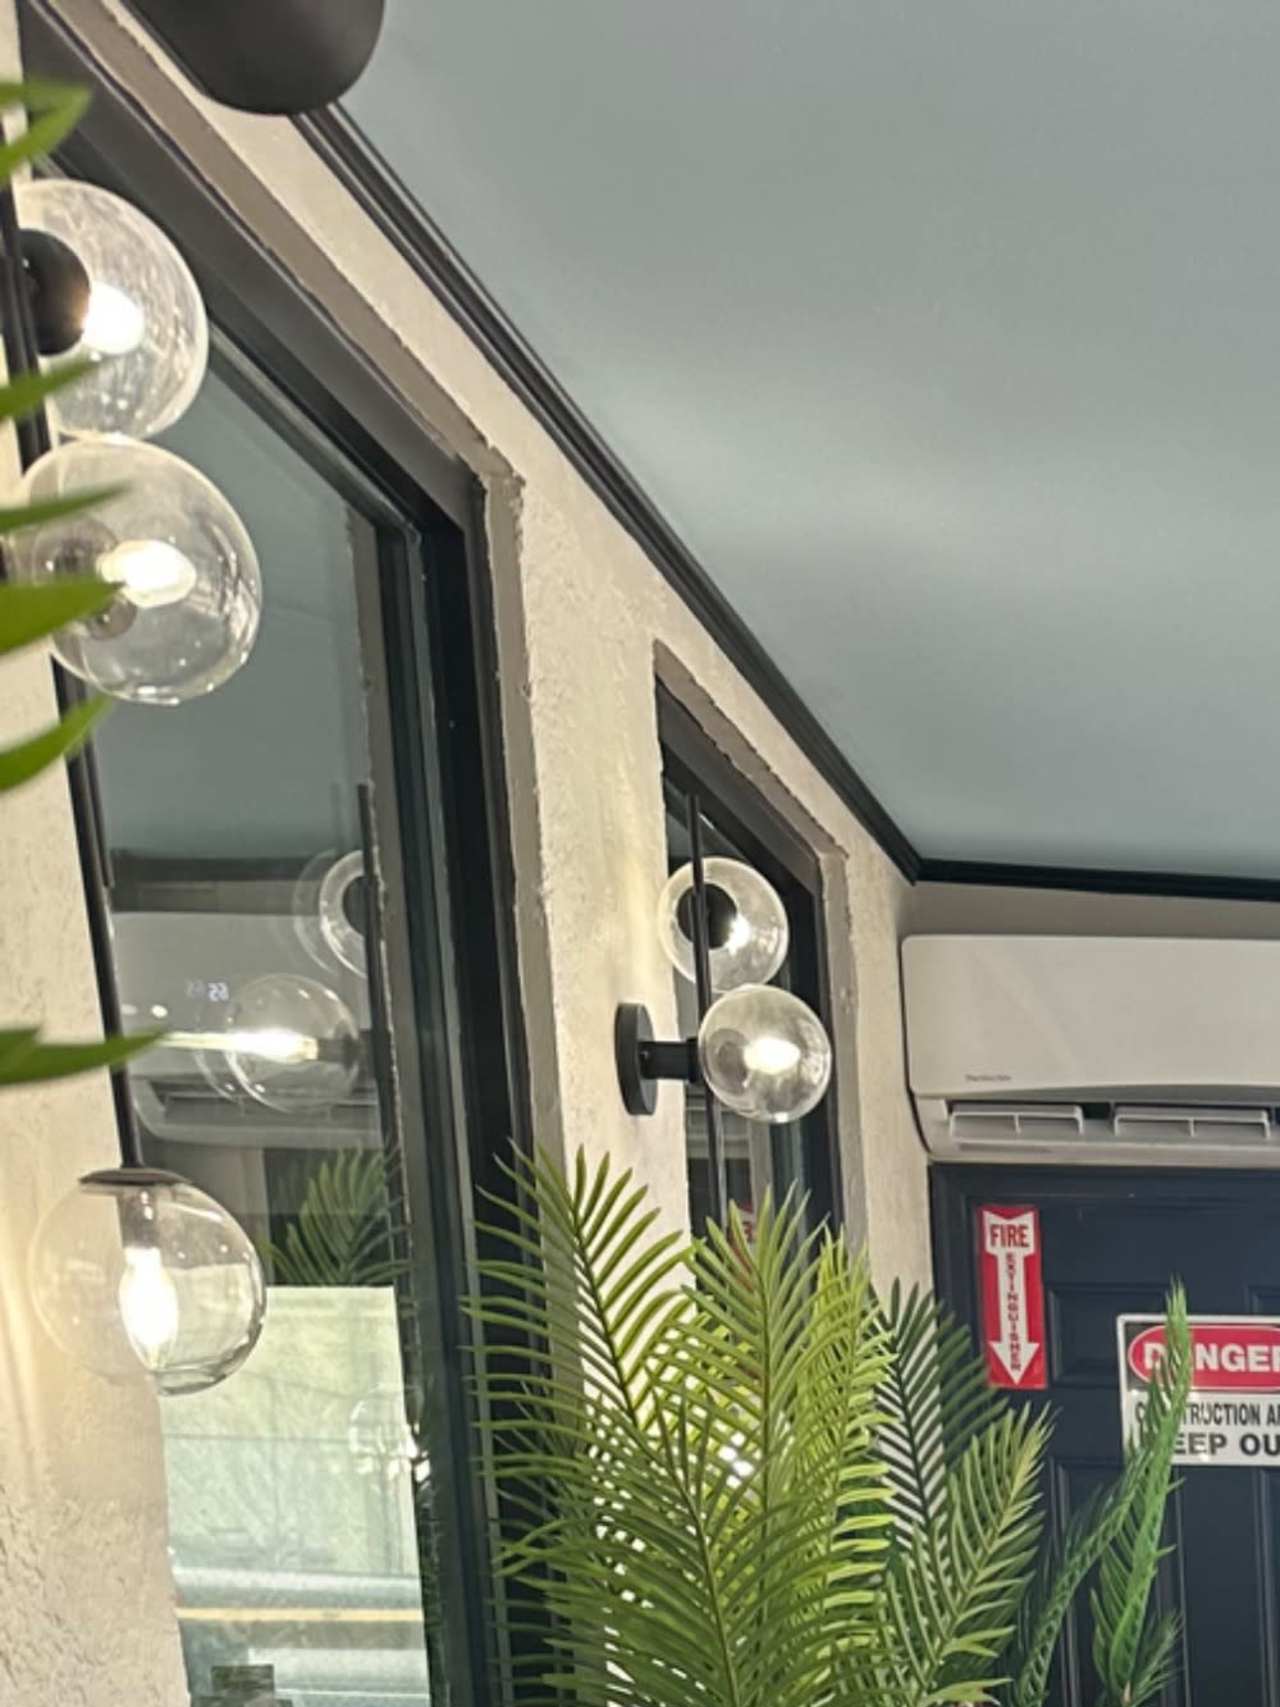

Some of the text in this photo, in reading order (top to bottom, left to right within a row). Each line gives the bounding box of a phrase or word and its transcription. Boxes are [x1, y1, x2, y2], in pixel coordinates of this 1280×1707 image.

[989, 1223, 1030, 1248] FIRE
[1005, 1252, 1022, 1371] EXTINGUISHER
[1171, 1431, 1227, 1456] EEP
